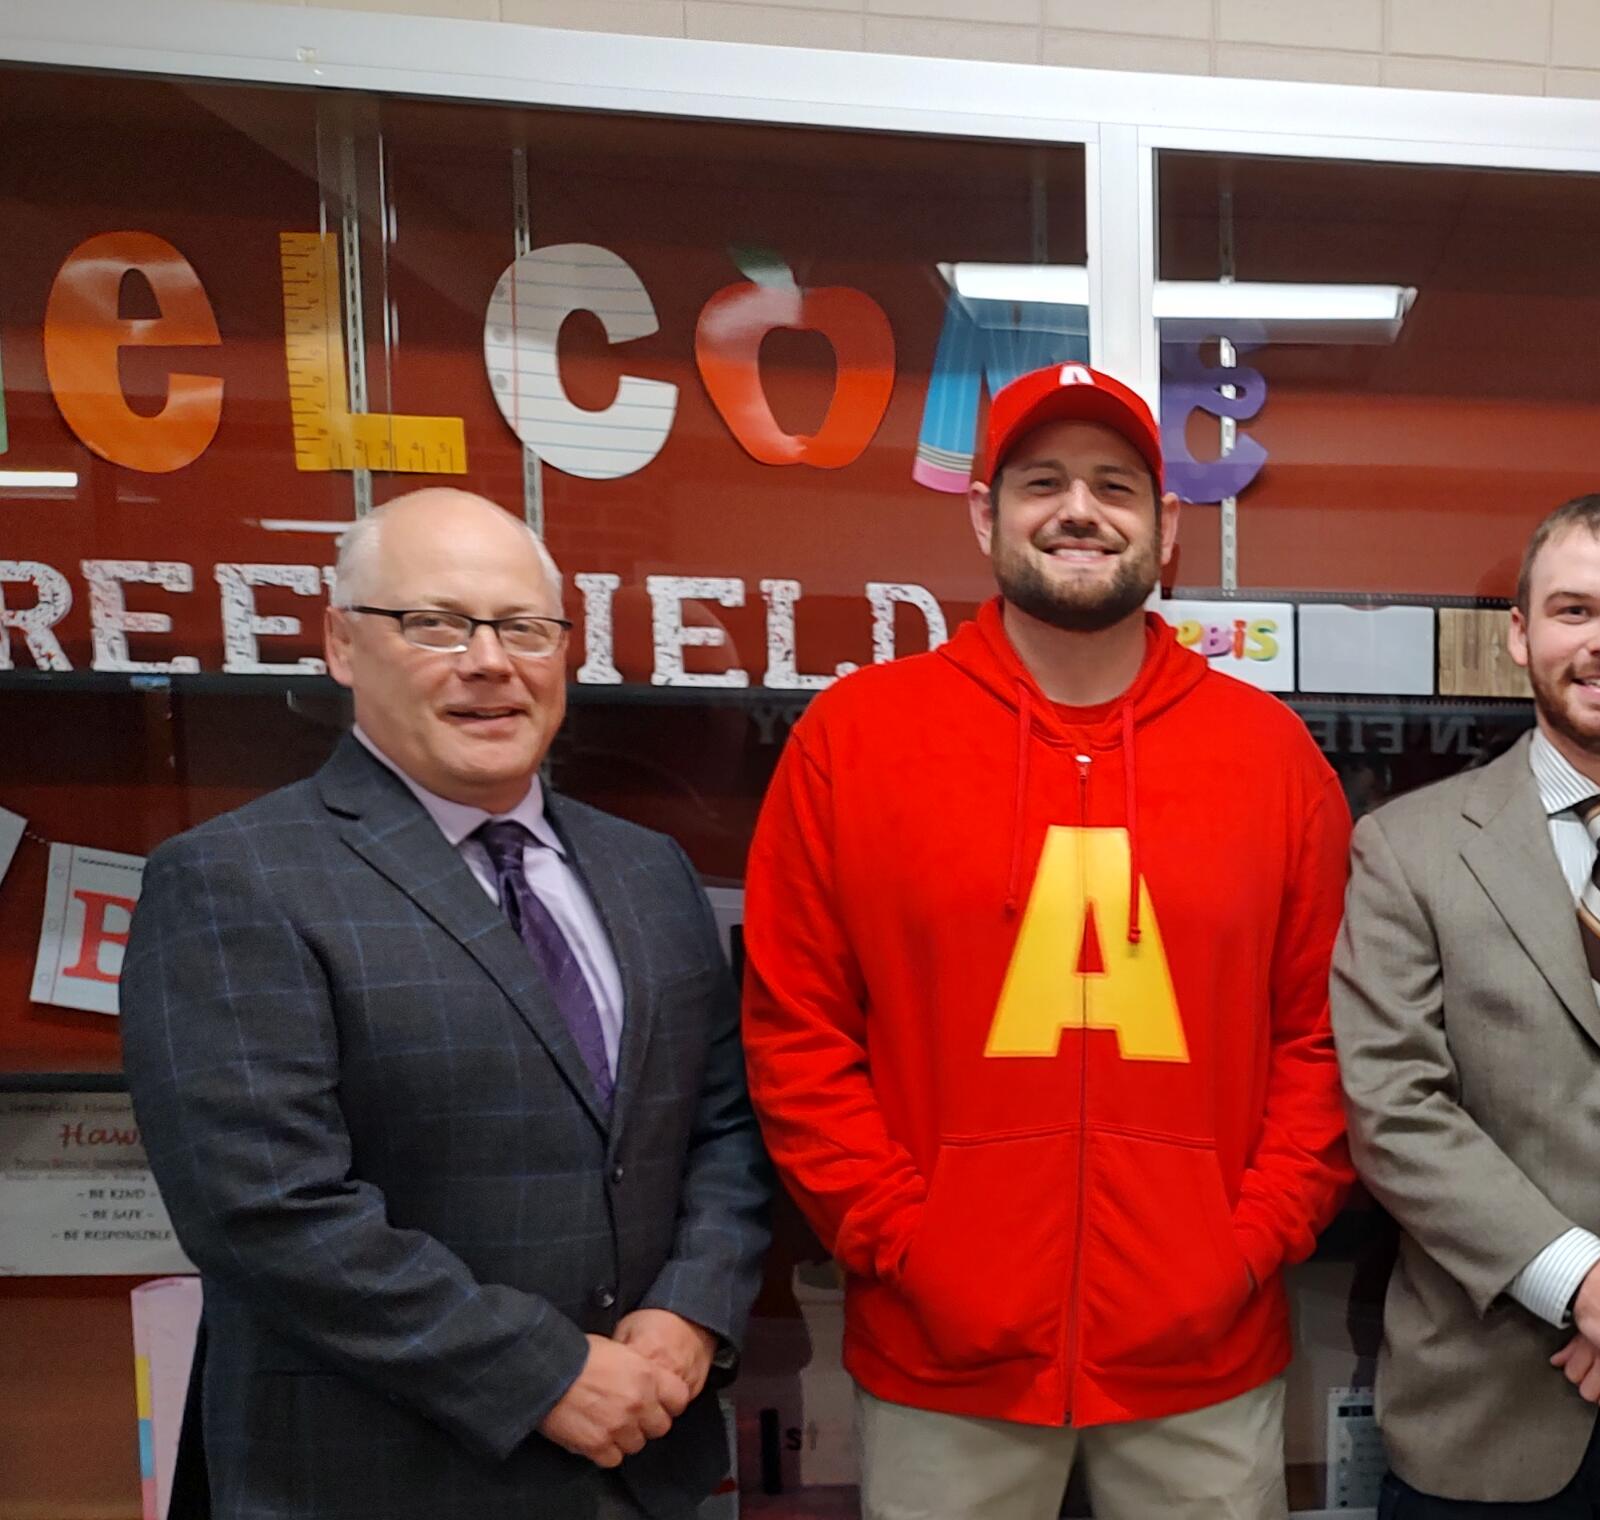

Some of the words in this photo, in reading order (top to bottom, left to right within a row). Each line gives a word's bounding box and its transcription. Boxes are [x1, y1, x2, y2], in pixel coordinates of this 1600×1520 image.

[984, 824, 1191, 1064] A
[89, 1188, 105, 1200] BE
[110, 1188, 147, 1200] KIND
[112, 1209, 144, 1221] SAFE
[63, 1229, 79, 1241] BE
[84, 1229, 173, 1242] RESPONSIBLE
